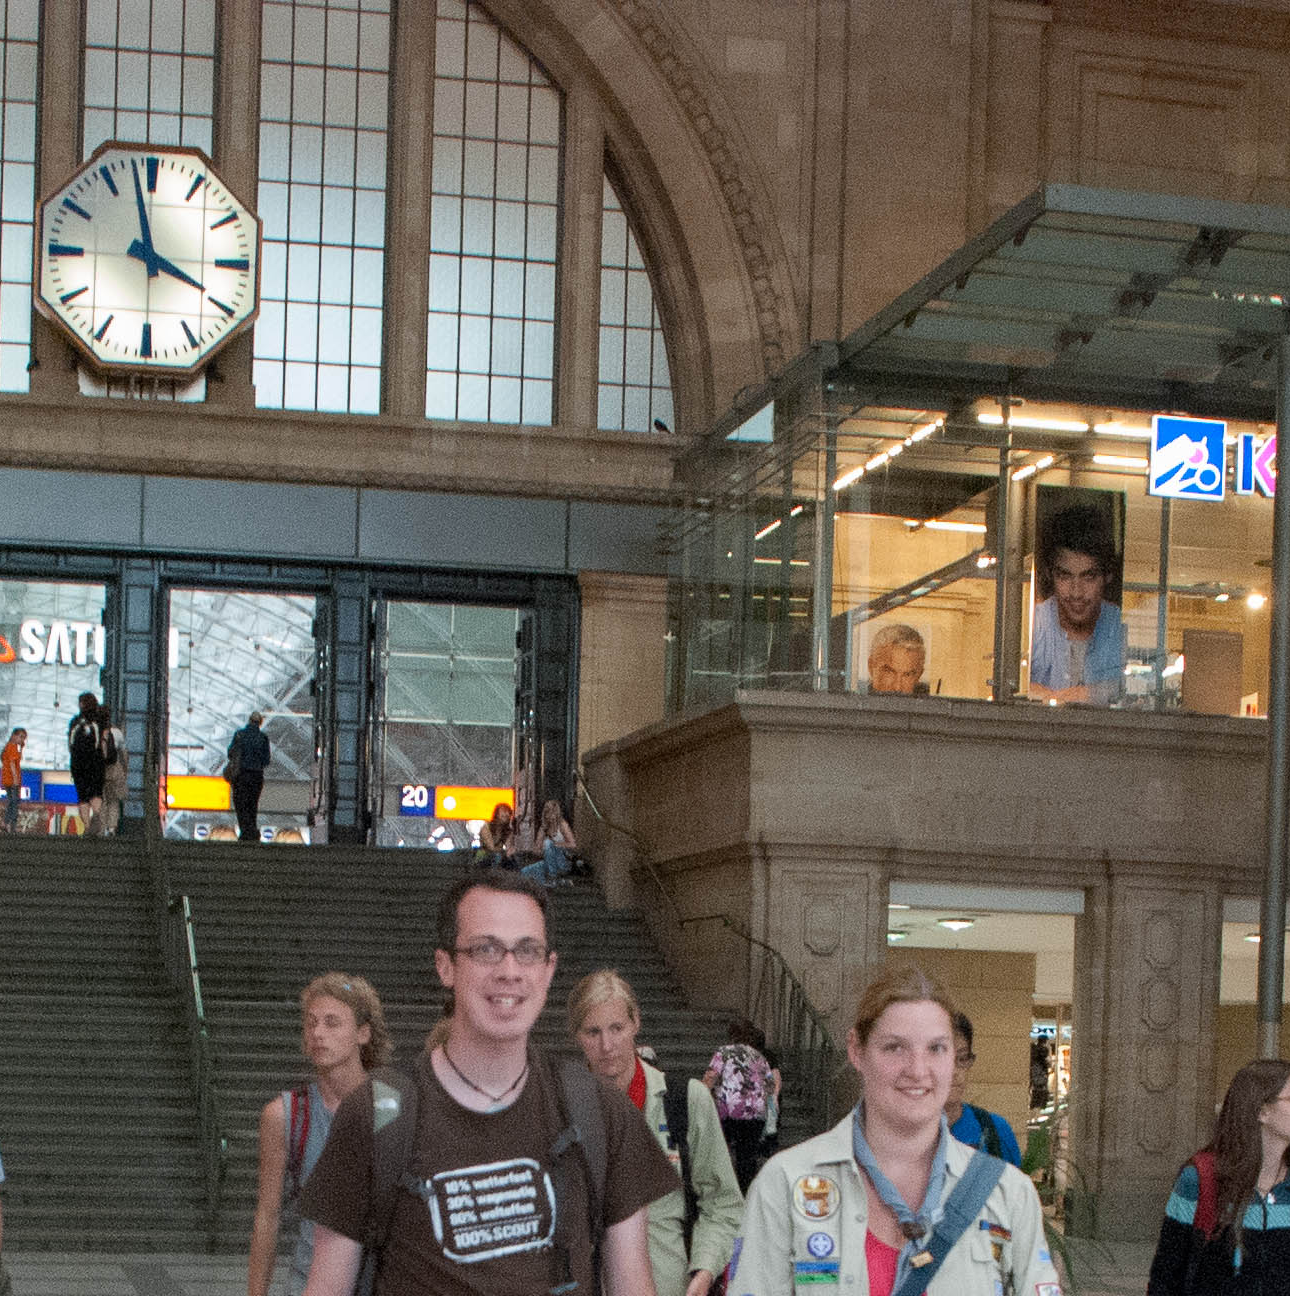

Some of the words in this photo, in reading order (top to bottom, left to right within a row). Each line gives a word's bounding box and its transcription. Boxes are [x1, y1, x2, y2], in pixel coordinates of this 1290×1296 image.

[401, 784, 429, 808] 20
[445, 1180, 471, 1194] 10%
[454, 1229, 493, 1249] 100%
[493, 1220, 539, 1240] SCOUT
